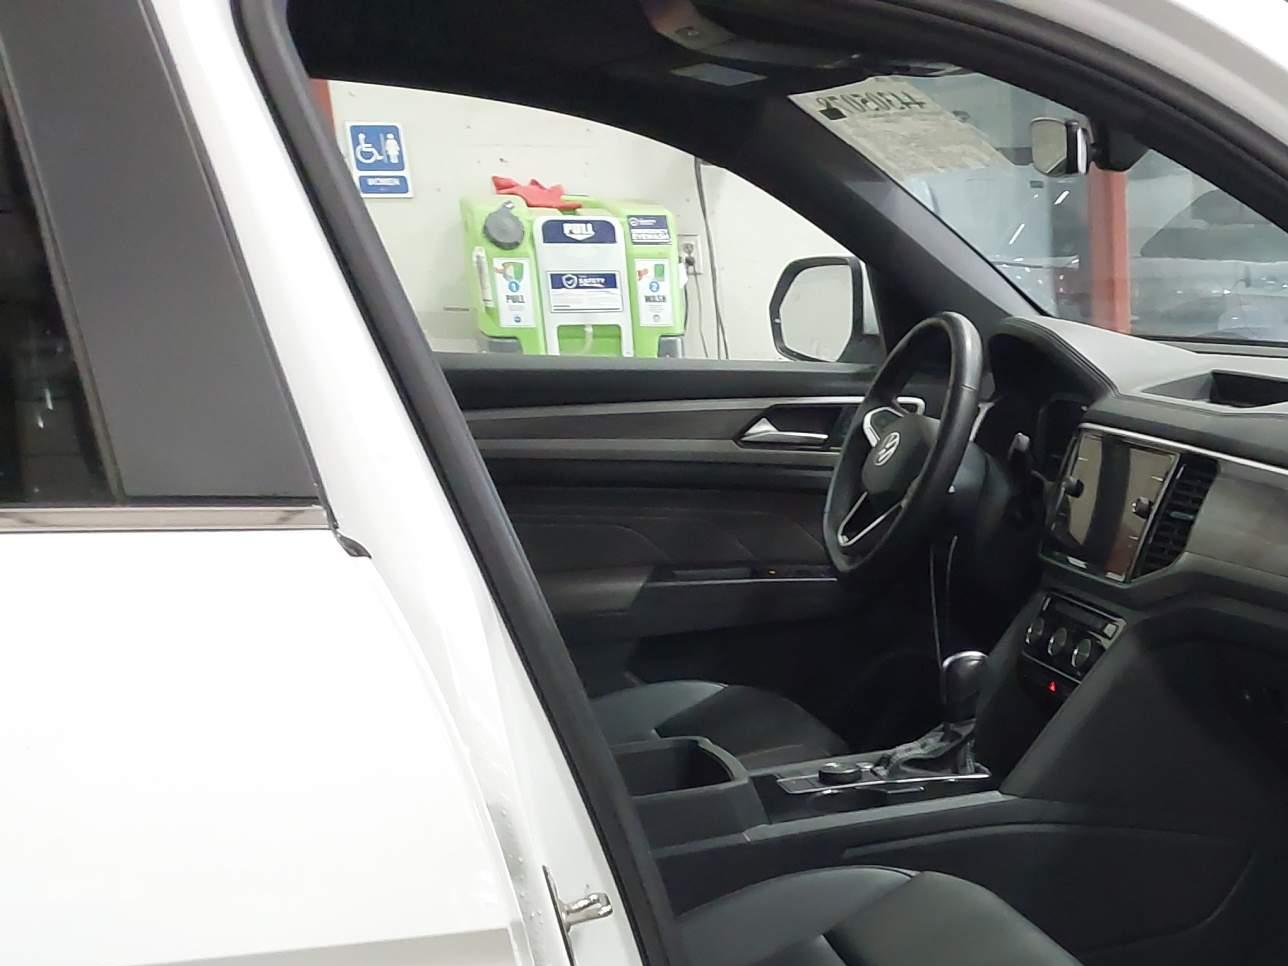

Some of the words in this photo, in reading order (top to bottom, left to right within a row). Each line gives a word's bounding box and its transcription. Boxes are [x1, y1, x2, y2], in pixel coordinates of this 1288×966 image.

[562, 222, 595, 235] PULL
[505, 294, 525, 303] PULL
[645, 295, 666, 303] WASH
